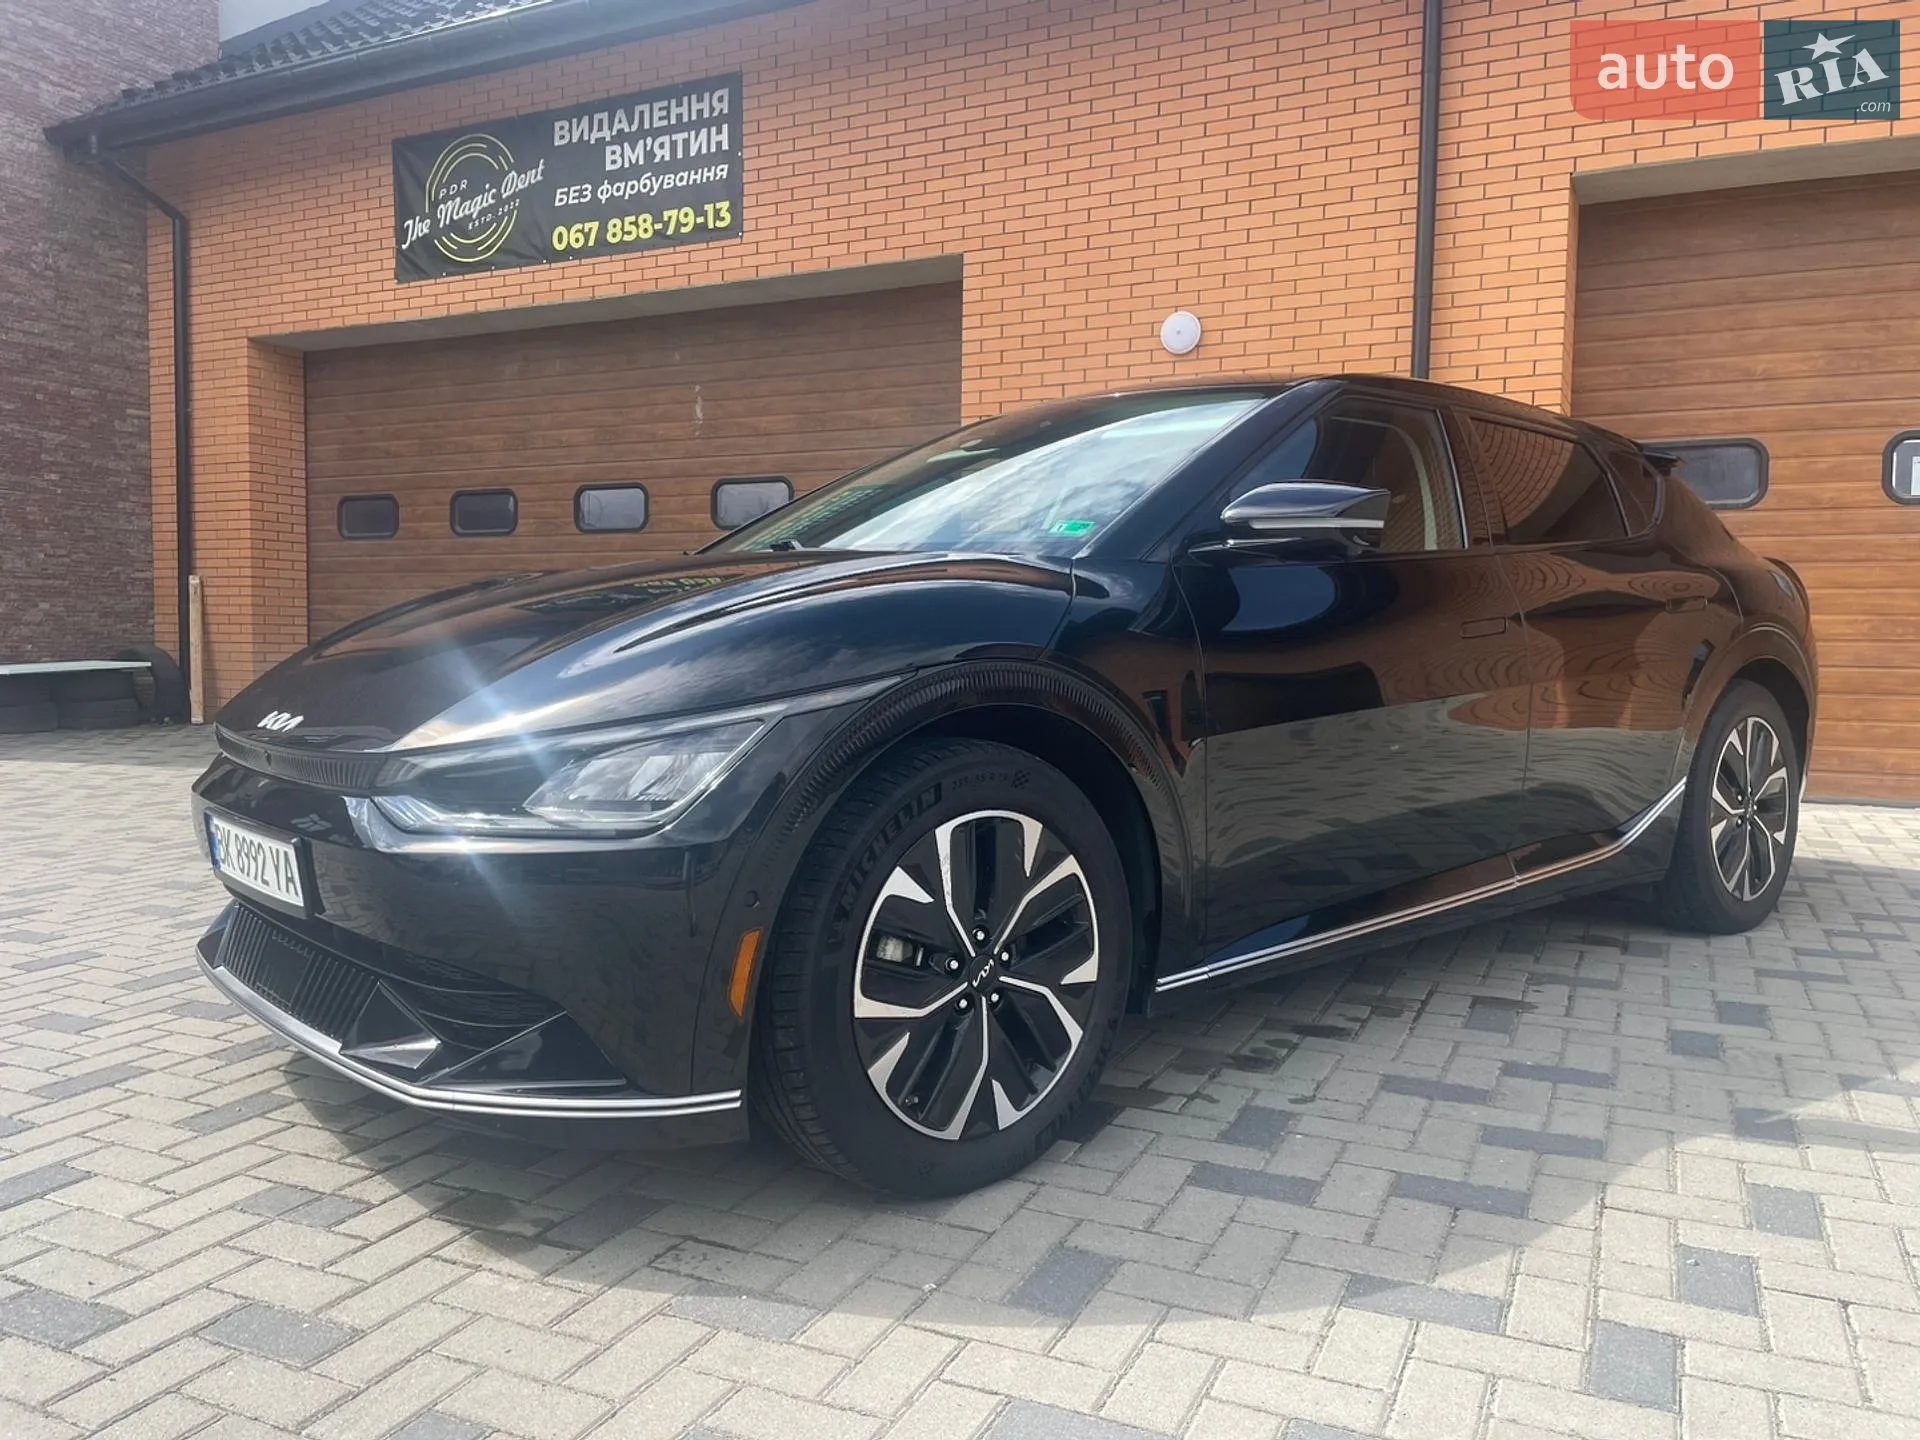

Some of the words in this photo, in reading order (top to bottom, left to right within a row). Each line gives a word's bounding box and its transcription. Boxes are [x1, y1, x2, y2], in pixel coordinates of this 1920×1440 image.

[553, 88, 729, 147] ВИДАЛЕННЯ
[605, 124, 729, 171] ВМ'ЯТИН
[401, 216, 431, 249] The
[437, 184, 496, 228] Magic
[501, 158, 545, 198] Dent
[438, 179, 468, 199] PDR
[554, 183, 593, 207] БЕЗ
[598, 164, 729, 203] фарбування
[552, 222, 600, 251] 067
[606, 200, 732, 244] 858-79-13
[234, 833, 270, 886] 8992
[269, 846, 300, 897] YA
[840, 784, 937, 911] MICHELIN
